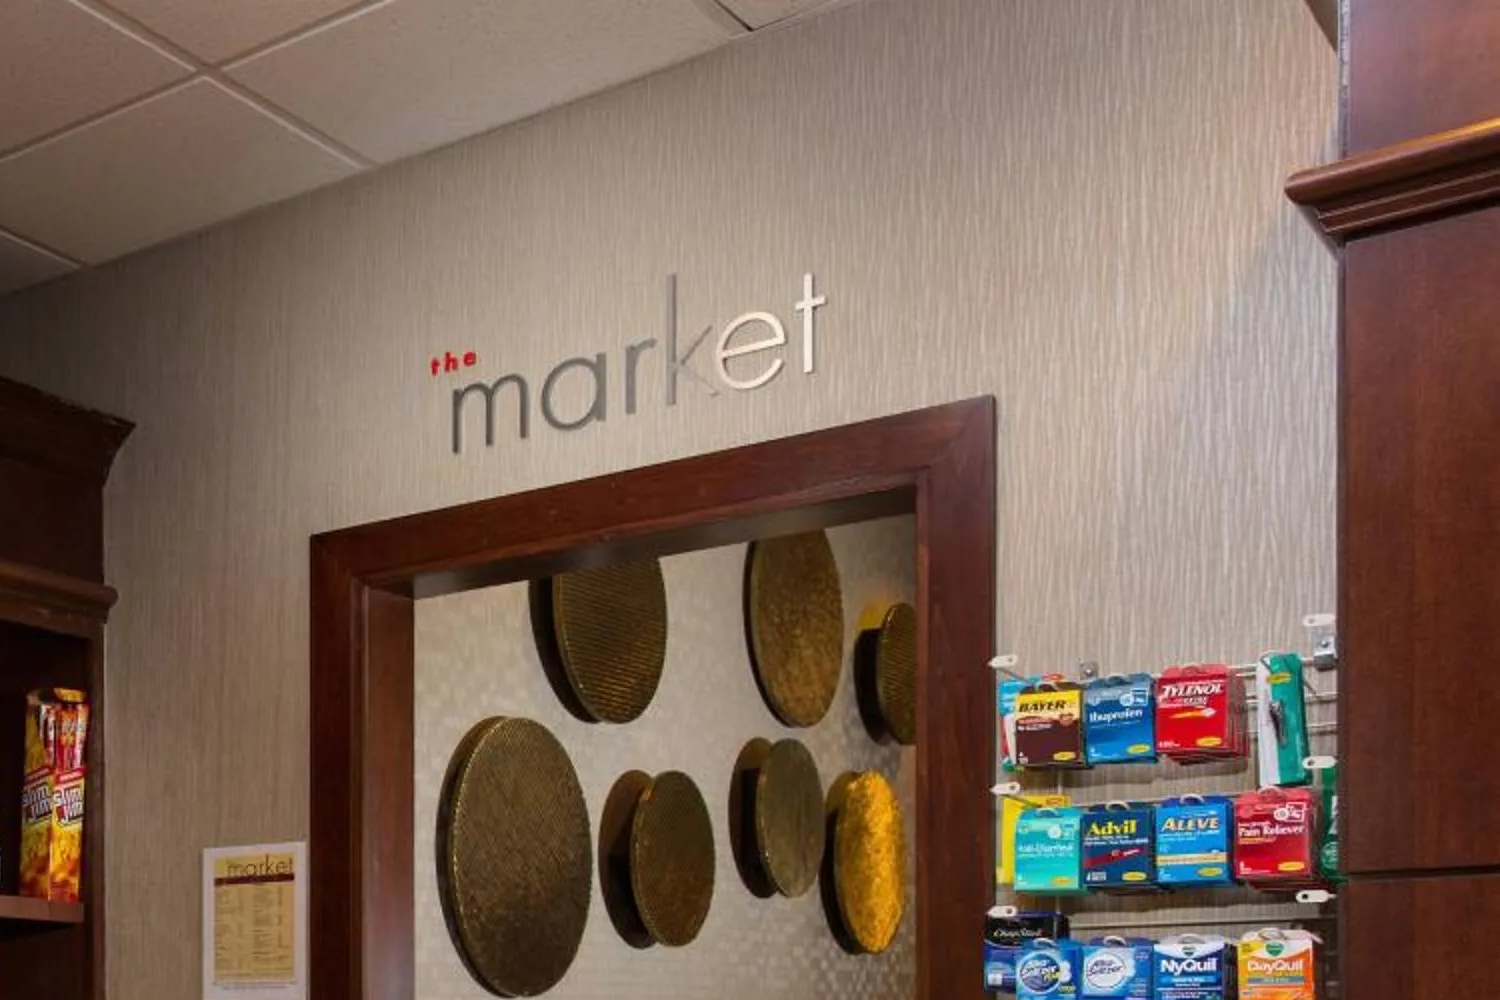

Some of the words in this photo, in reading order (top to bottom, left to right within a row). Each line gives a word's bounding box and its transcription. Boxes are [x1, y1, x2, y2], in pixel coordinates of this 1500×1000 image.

[430, 351, 477, 376] the
[452, 273, 827, 454] market
[1161, 684, 1223, 698] TYLENOL
[1019, 700, 1067, 713] BAYER
[1090, 708, 1143, 723] Ibuprofen
[1086, 819, 1137, 836] Advil
[1162, 816, 1220, 831] ALEVE
[226, 854, 293, 877] market
[1160, 957, 1217, 976] NyQuil
[1247, 959, 1303, 975] DayQuil
